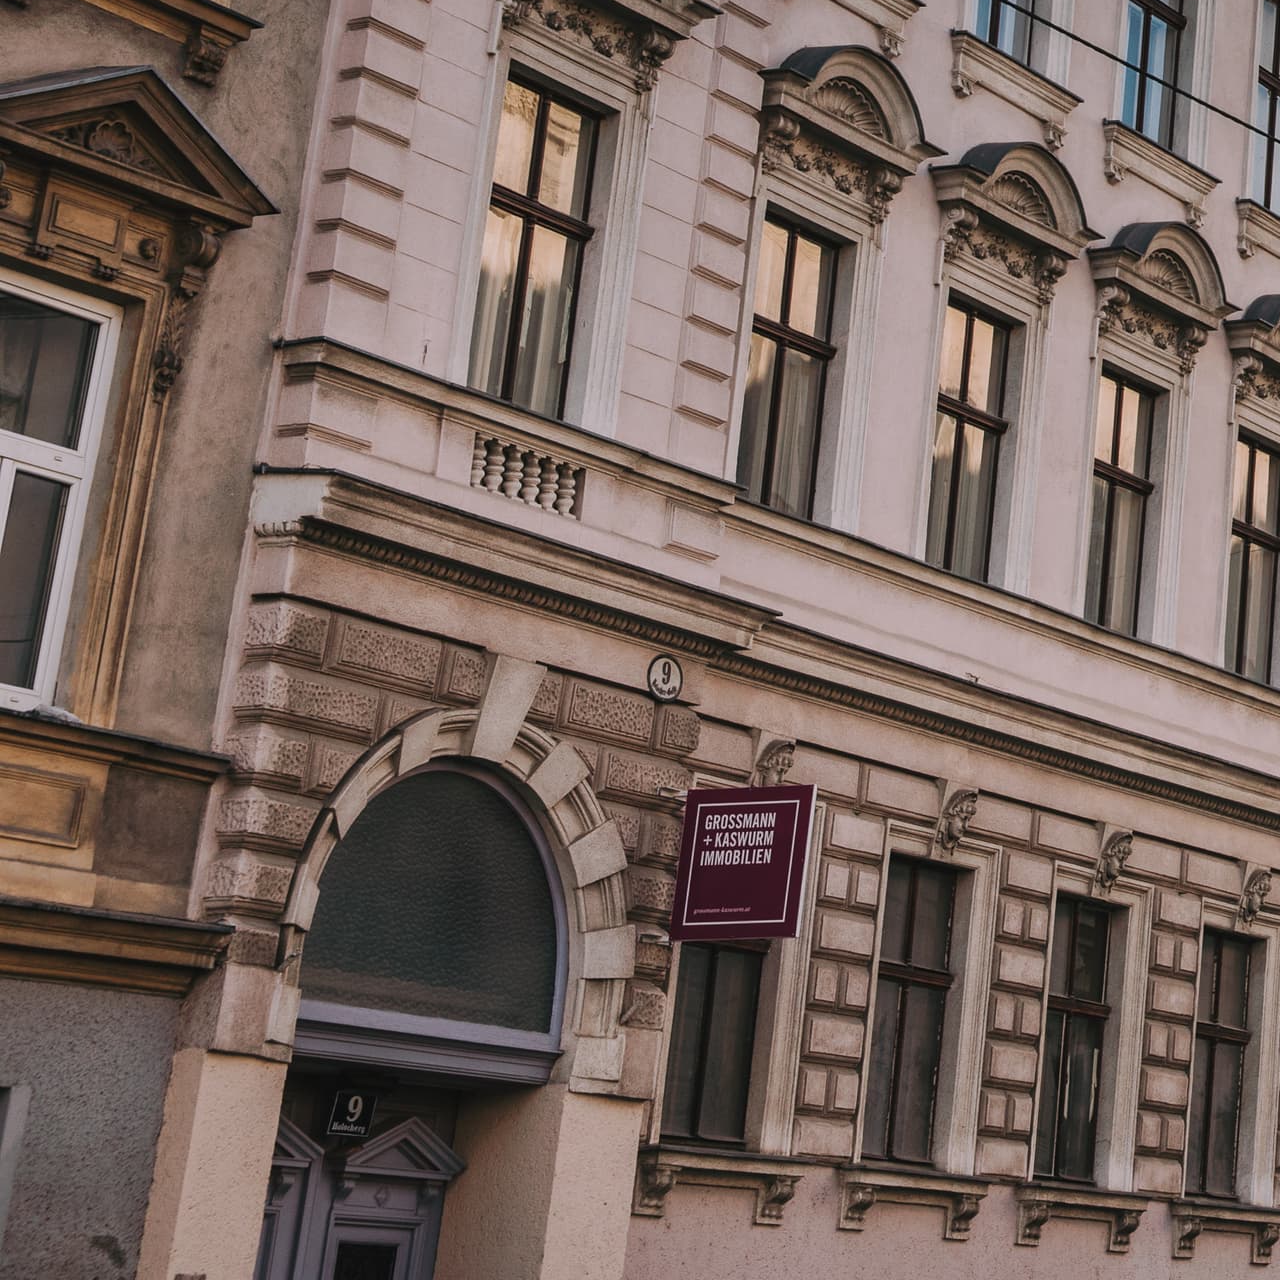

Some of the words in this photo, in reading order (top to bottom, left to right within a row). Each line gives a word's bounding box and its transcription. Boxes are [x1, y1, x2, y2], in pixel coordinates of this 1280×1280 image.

[662, 661, 672, 685] 9
[705, 812, 777, 830] GROSSMANN
[703, 835, 712, 846] +
[714, 830, 774, 848] KASWURM
[700, 848, 772, 866] IMMOBILIEN
[346, 1095, 363, 1122] 9
